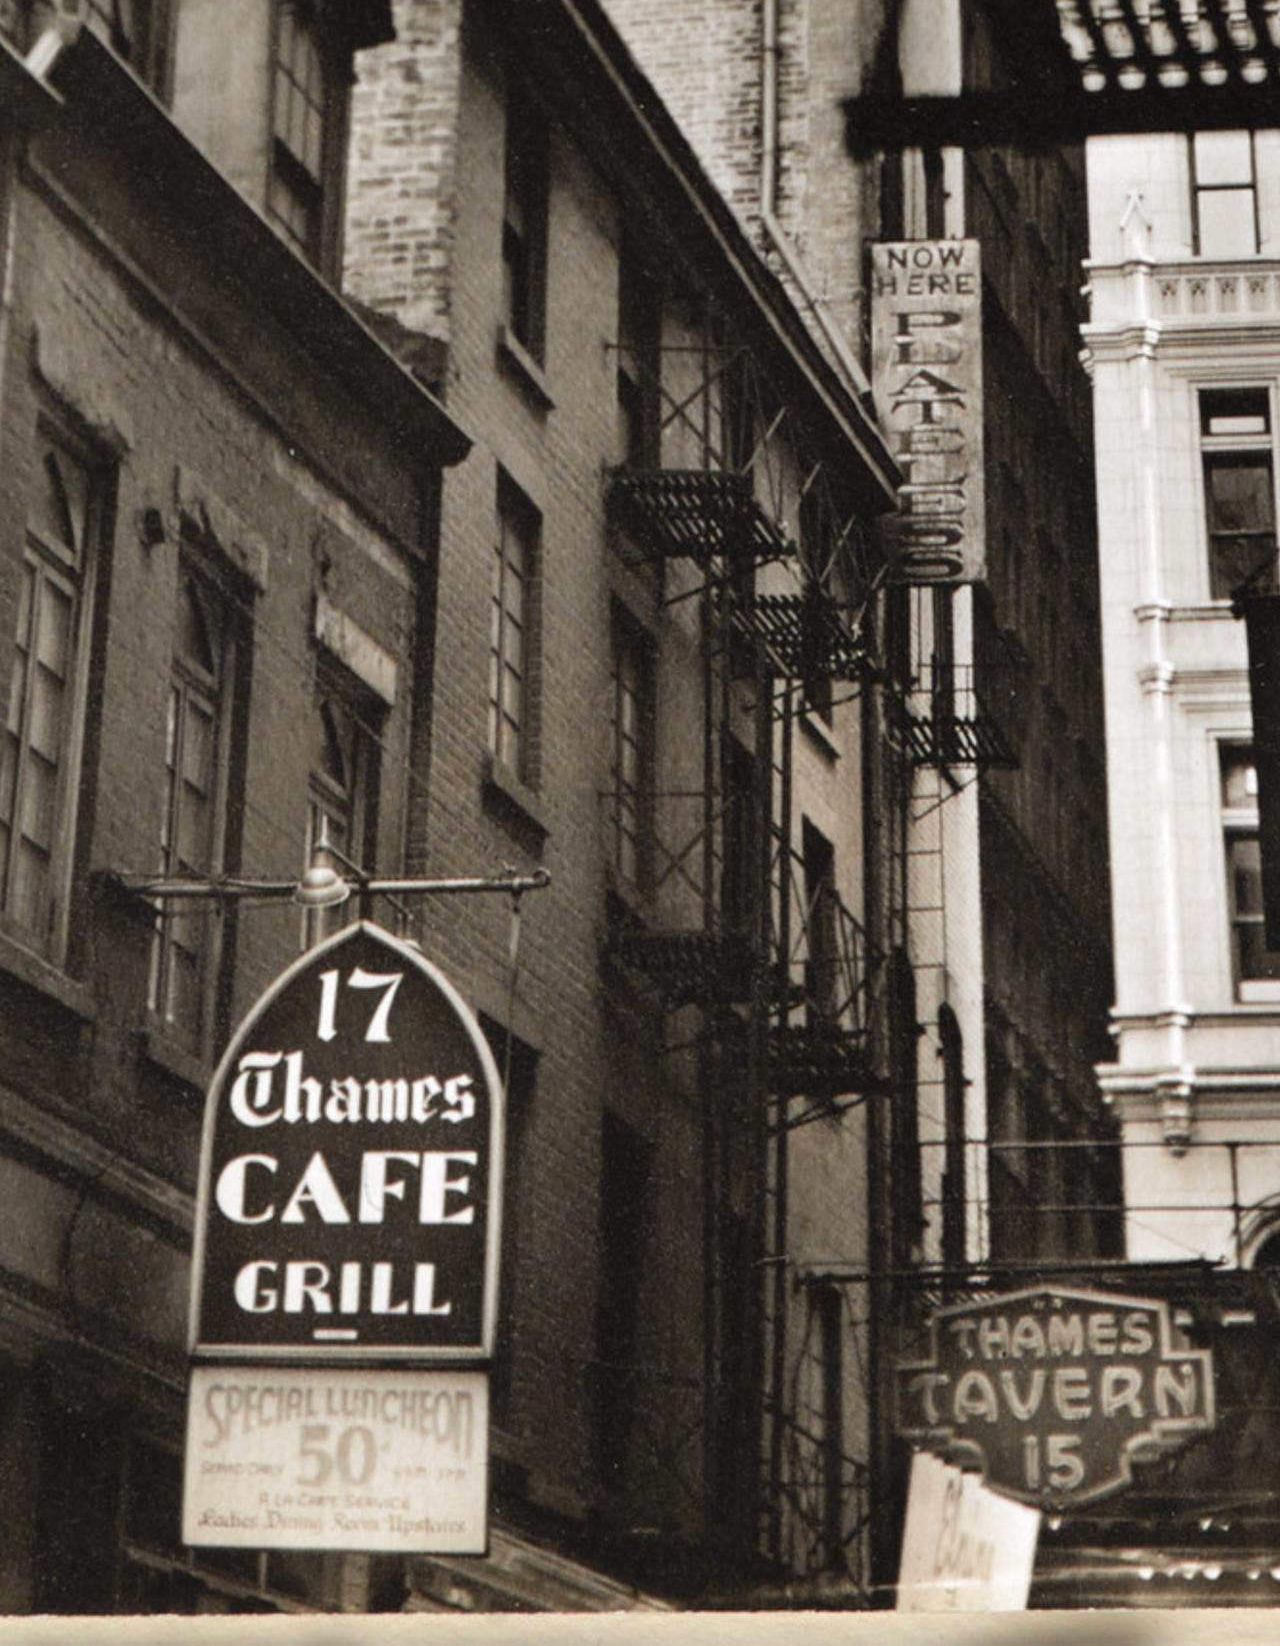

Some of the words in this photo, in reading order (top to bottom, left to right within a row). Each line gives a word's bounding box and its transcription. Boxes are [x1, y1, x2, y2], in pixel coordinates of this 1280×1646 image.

[877, 272, 976, 297] HERE
[887, 247, 964, 269] NOW
[317, 966, 404, 1043] 17
[230, 1049, 477, 1128] Thames
[215, 1150, 479, 1225] CAFE
[234, 1259, 452, 1316] GRILL
[948, 1311, 1155, 1360] THAMES
[203, 1383, 318, 1450] SPECIAL
[908, 1364, 1197, 1425] TAVERN
[1021, 1433, 1087, 1490] 15
